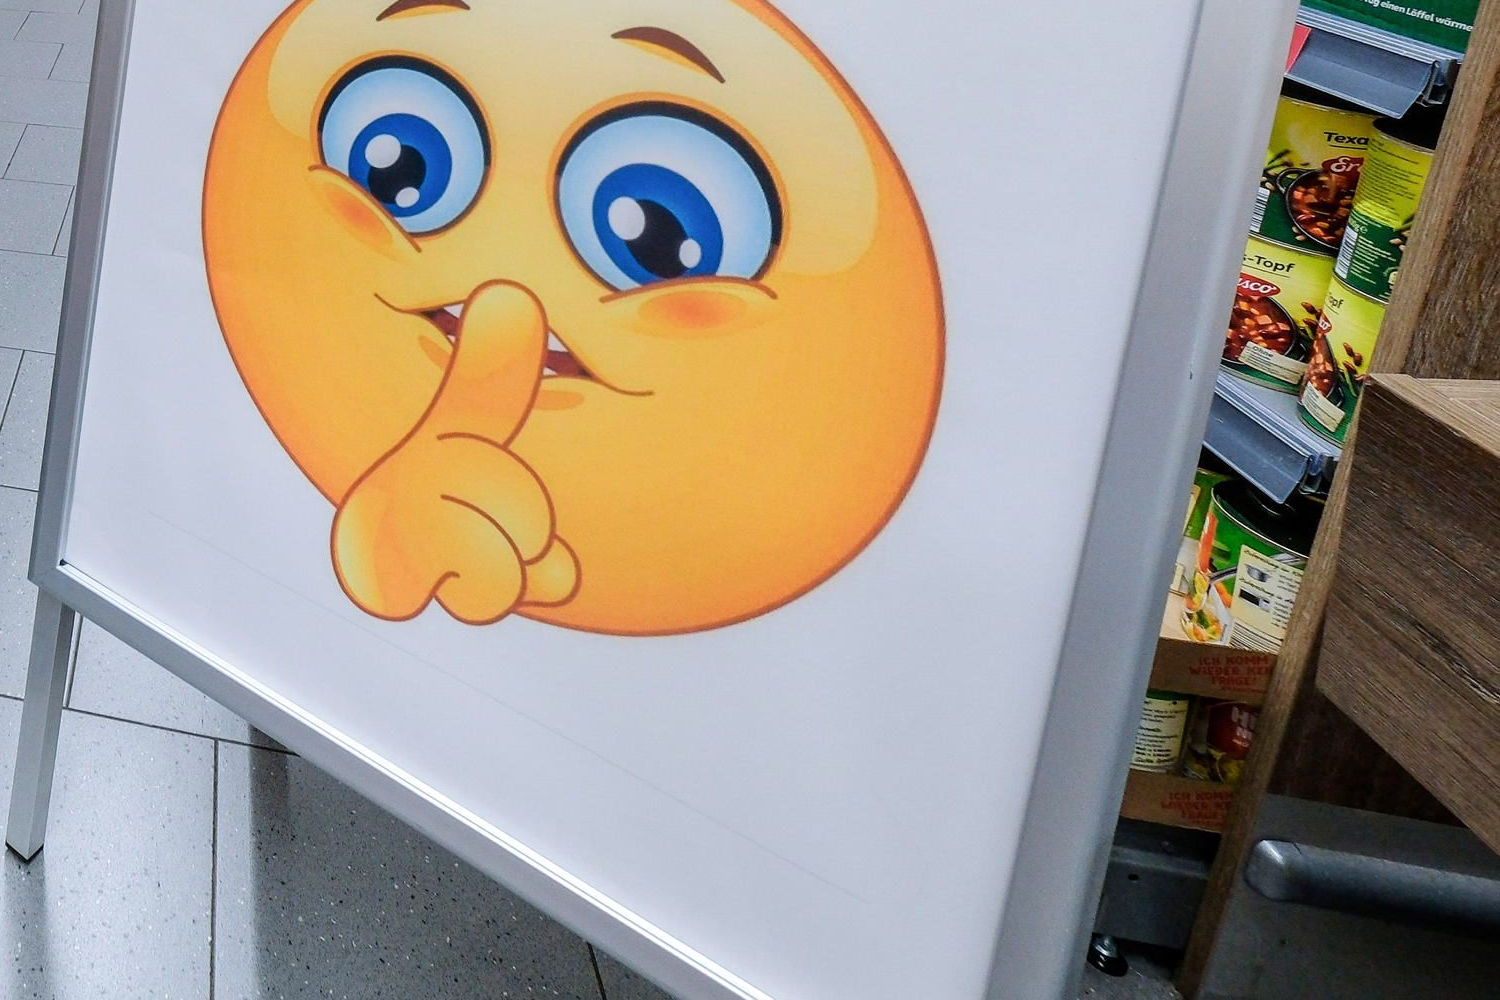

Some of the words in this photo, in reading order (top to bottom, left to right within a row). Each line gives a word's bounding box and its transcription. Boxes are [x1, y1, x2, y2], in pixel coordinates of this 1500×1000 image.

[1380, 0, 1406, 15] einen
[1406, 6, 1435, 23] Löffel
[1435, 15, 1474, 34] wärme
[1323, 131, 1370, 147] Texa
[1243, 252, 1296, 275] -Topf
[1236, 276, 1279, 295] asco
